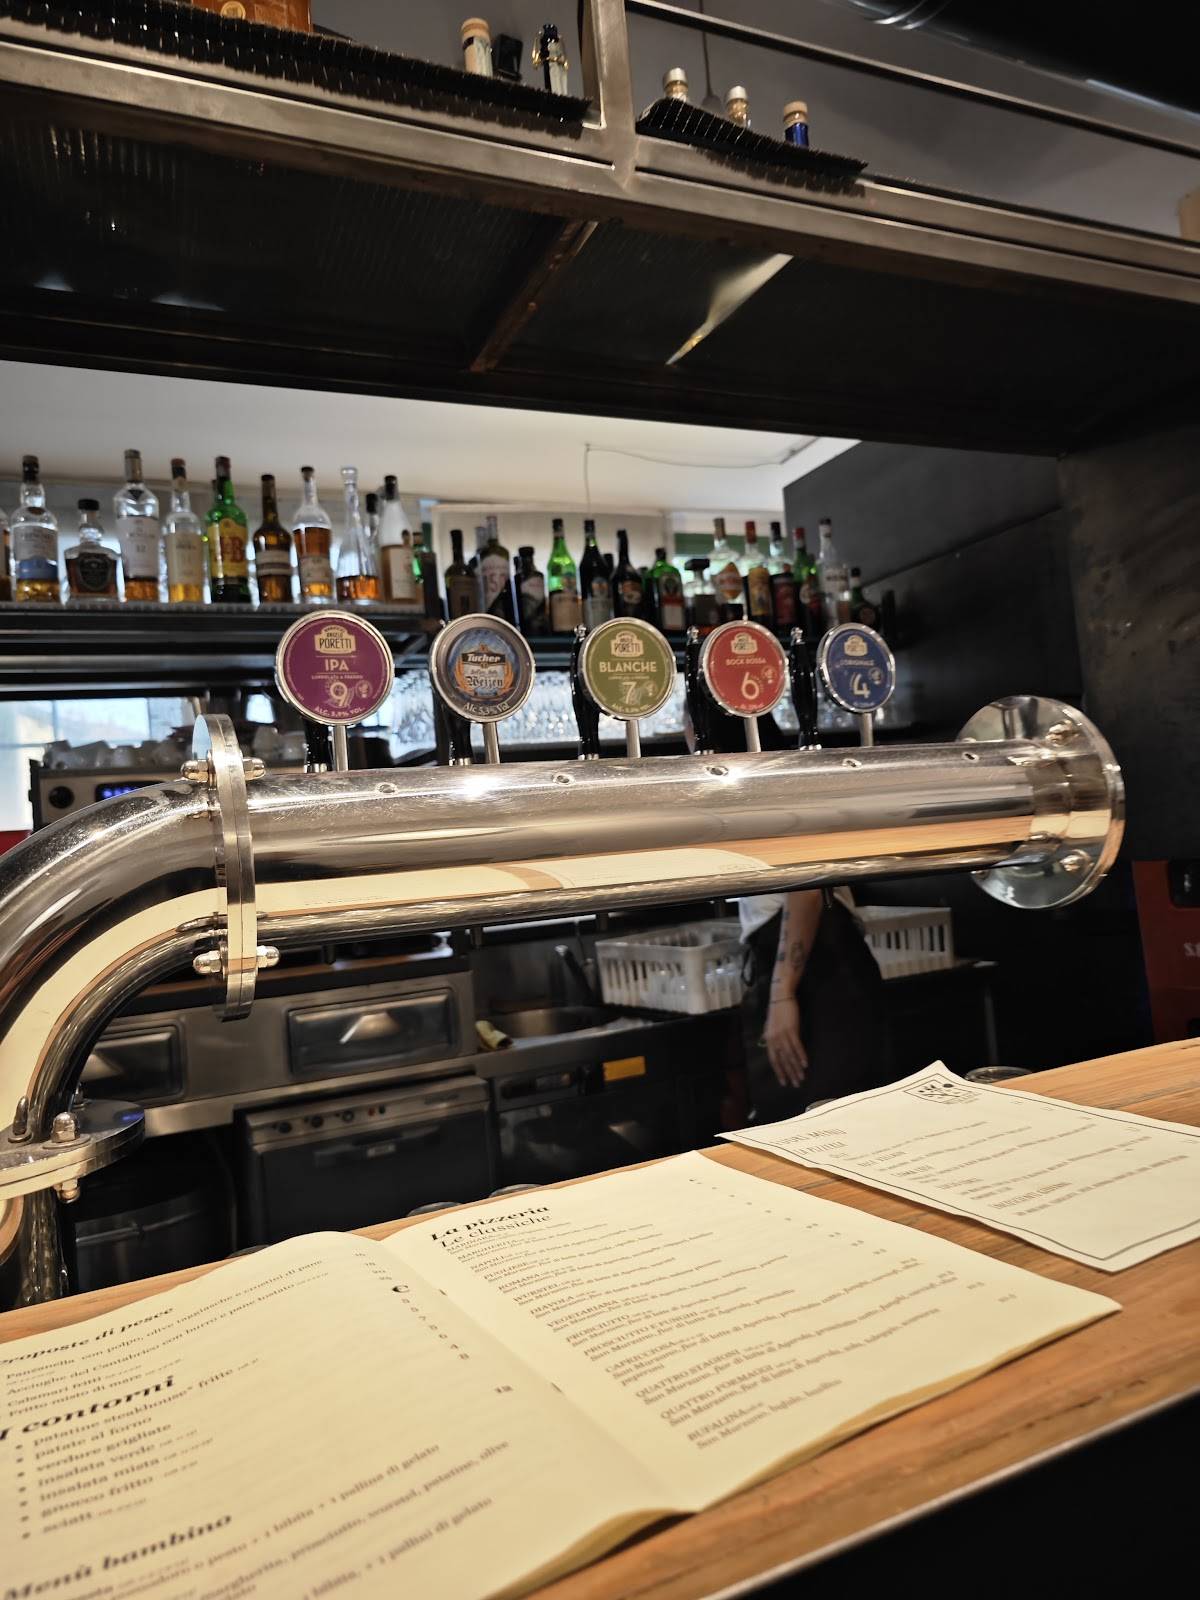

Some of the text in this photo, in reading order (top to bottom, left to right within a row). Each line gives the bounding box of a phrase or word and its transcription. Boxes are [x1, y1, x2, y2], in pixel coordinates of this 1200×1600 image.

[319, 638, 351, 648] PORETTI
[325, 659, 349, 671] IPA
[468, 654, 500, 662] Tucher
[599, 661, 656, 672] BLANCHE
[329, 681, 348, 706] 9
[622, 681, 637, 704] 7
[741, 672, 759, 700] 6
[853, 673, 870, 698] 4
[431, 1225, 458, 1241] La
[464, 1206, 550, 1230] pizzeria
[440, 1234, 464, 1248] Le
[469, 1214, 552, 1240] classiche
[498, 1272, 540, 1291] ROMANA
[530, 1296, 574, 1314] DIAVOLA
[546, 1300, 619, 1327] VEGETARIANA
[96, 1328, 113, 1340] di
[121, 1308, 172, 1332] pesce
[566, 1315, 632, 1343] PROSCIUTTO
[584, 1326, 649, 1356] PROSCIUTTO
[70, 1369, 88, 1378] del
[162, 1334, 182, 1345] con
[82, 1351, 103, 1360] con
[605, 1341, 677, 1373] CAPRICCIOSA
[52, 1391, 89, 1405] misto
[109, 1374, 142, 1388] mare
[635, 1371, 693, 1398] QUATTRO
[22, 1376, 175, 1434] contorni
[660, 1390, 716, 1420] QUATTRO
[34, 1422, 99, 1446] patatine
[35, 1417, 151, 1460] patate al forno
[687, 1409, 749, 1441] BUFALINA
[36, 1448, 101, 1472] verdure
[38, 1444, 155, 1487] insalata verde
[40, 1458, 160, 1502] insalata mista
[4, 1515, 232, 1600] Menù bambino
